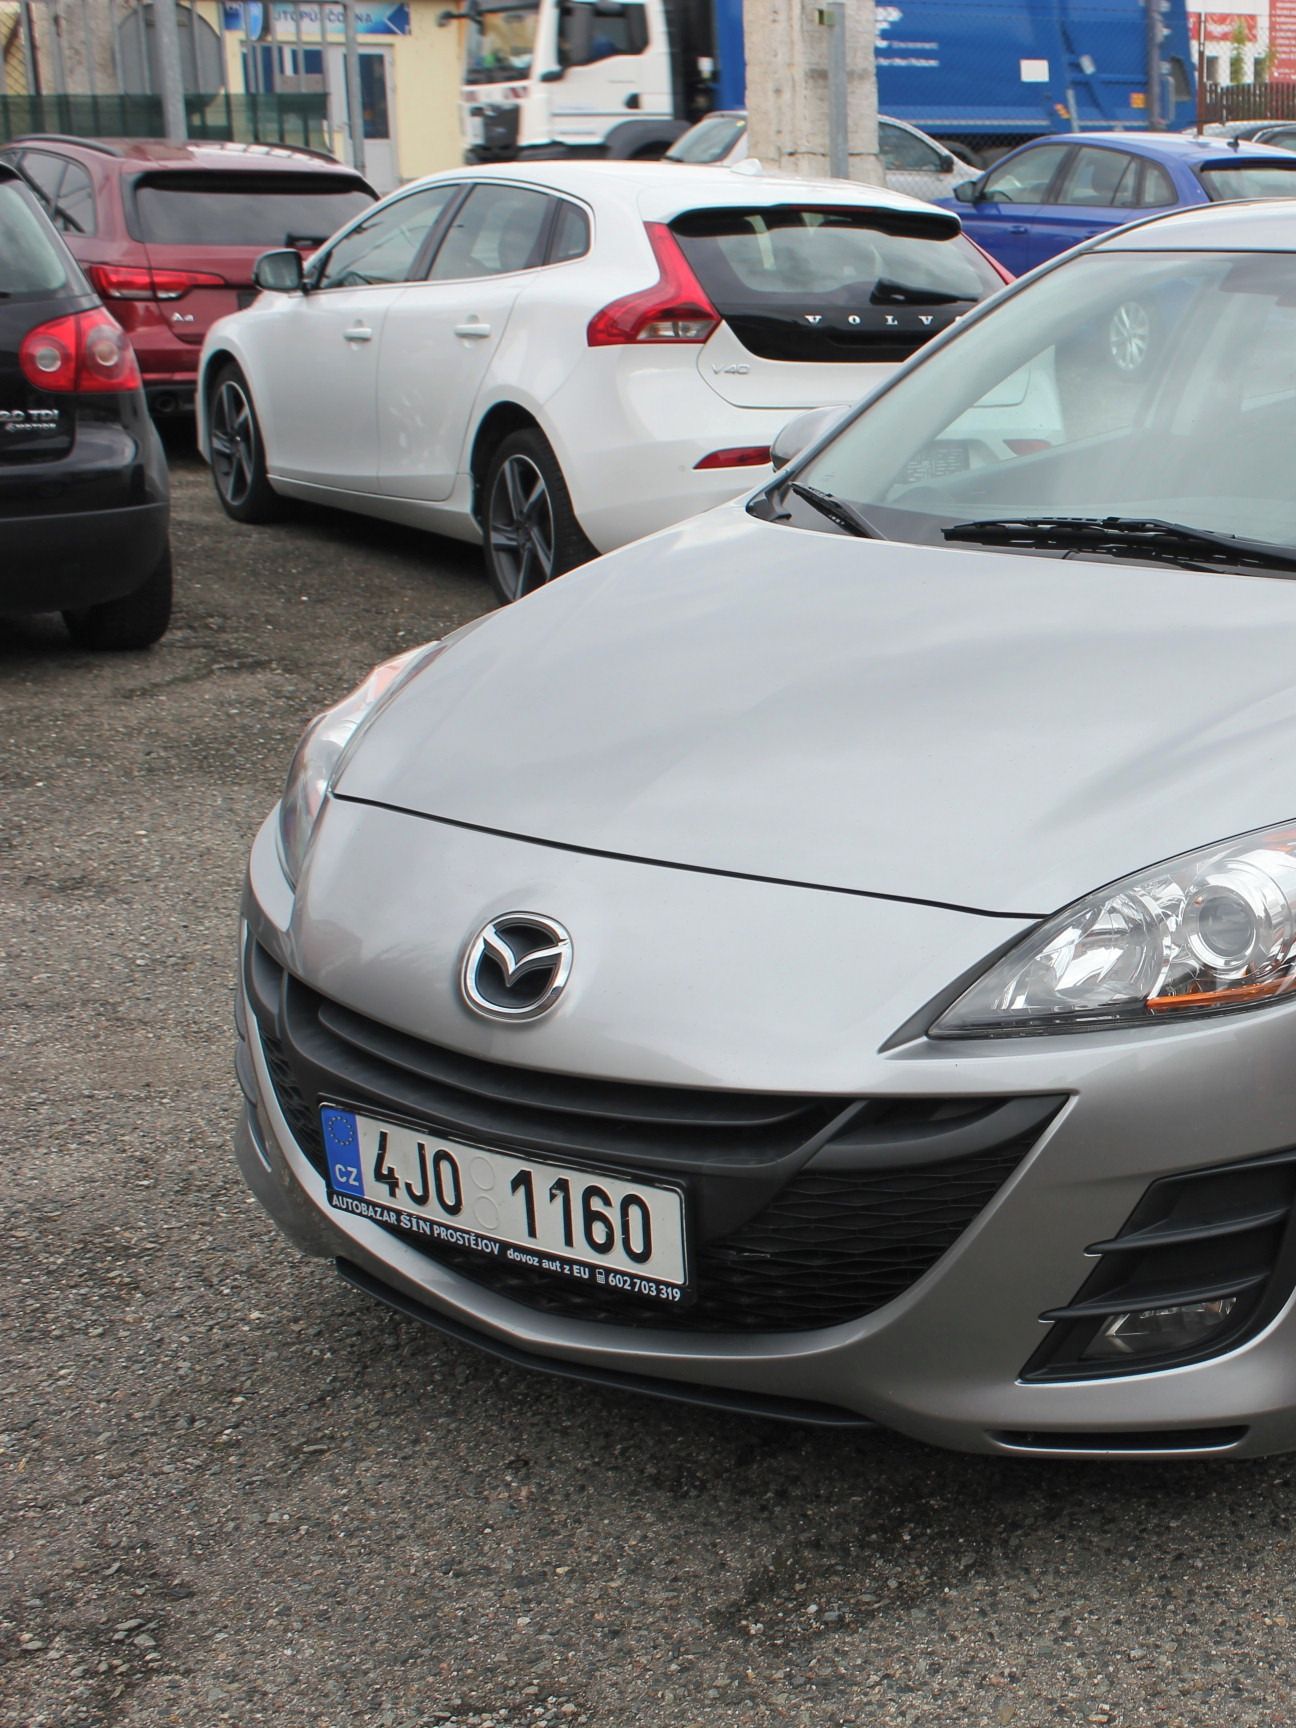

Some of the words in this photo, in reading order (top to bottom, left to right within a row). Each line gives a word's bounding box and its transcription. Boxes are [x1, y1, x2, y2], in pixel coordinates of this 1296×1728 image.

[27, 409, 59, 420] TDI
[335, 1163, 360, 1187] CZ
[510, 1168, 654, 1265] 1160
[331, 1193, 398, 1226] AUTOBAZAR
[400, 1212, 431, 1236] ŠÍN
[433, 1225, 500, 1256] PROSTĚJOV
[506, 1248, 540, 1267] dovoz
[542, 1258, 562, 1272] aut
[563, 1263, 571, 1275] z
[573, 1265, 589, 1279] EU
[608, 1272, 632, 1290] 602
[633, 1278, 657, 1296] 703
[659, 1284, 681, 1302] 319
